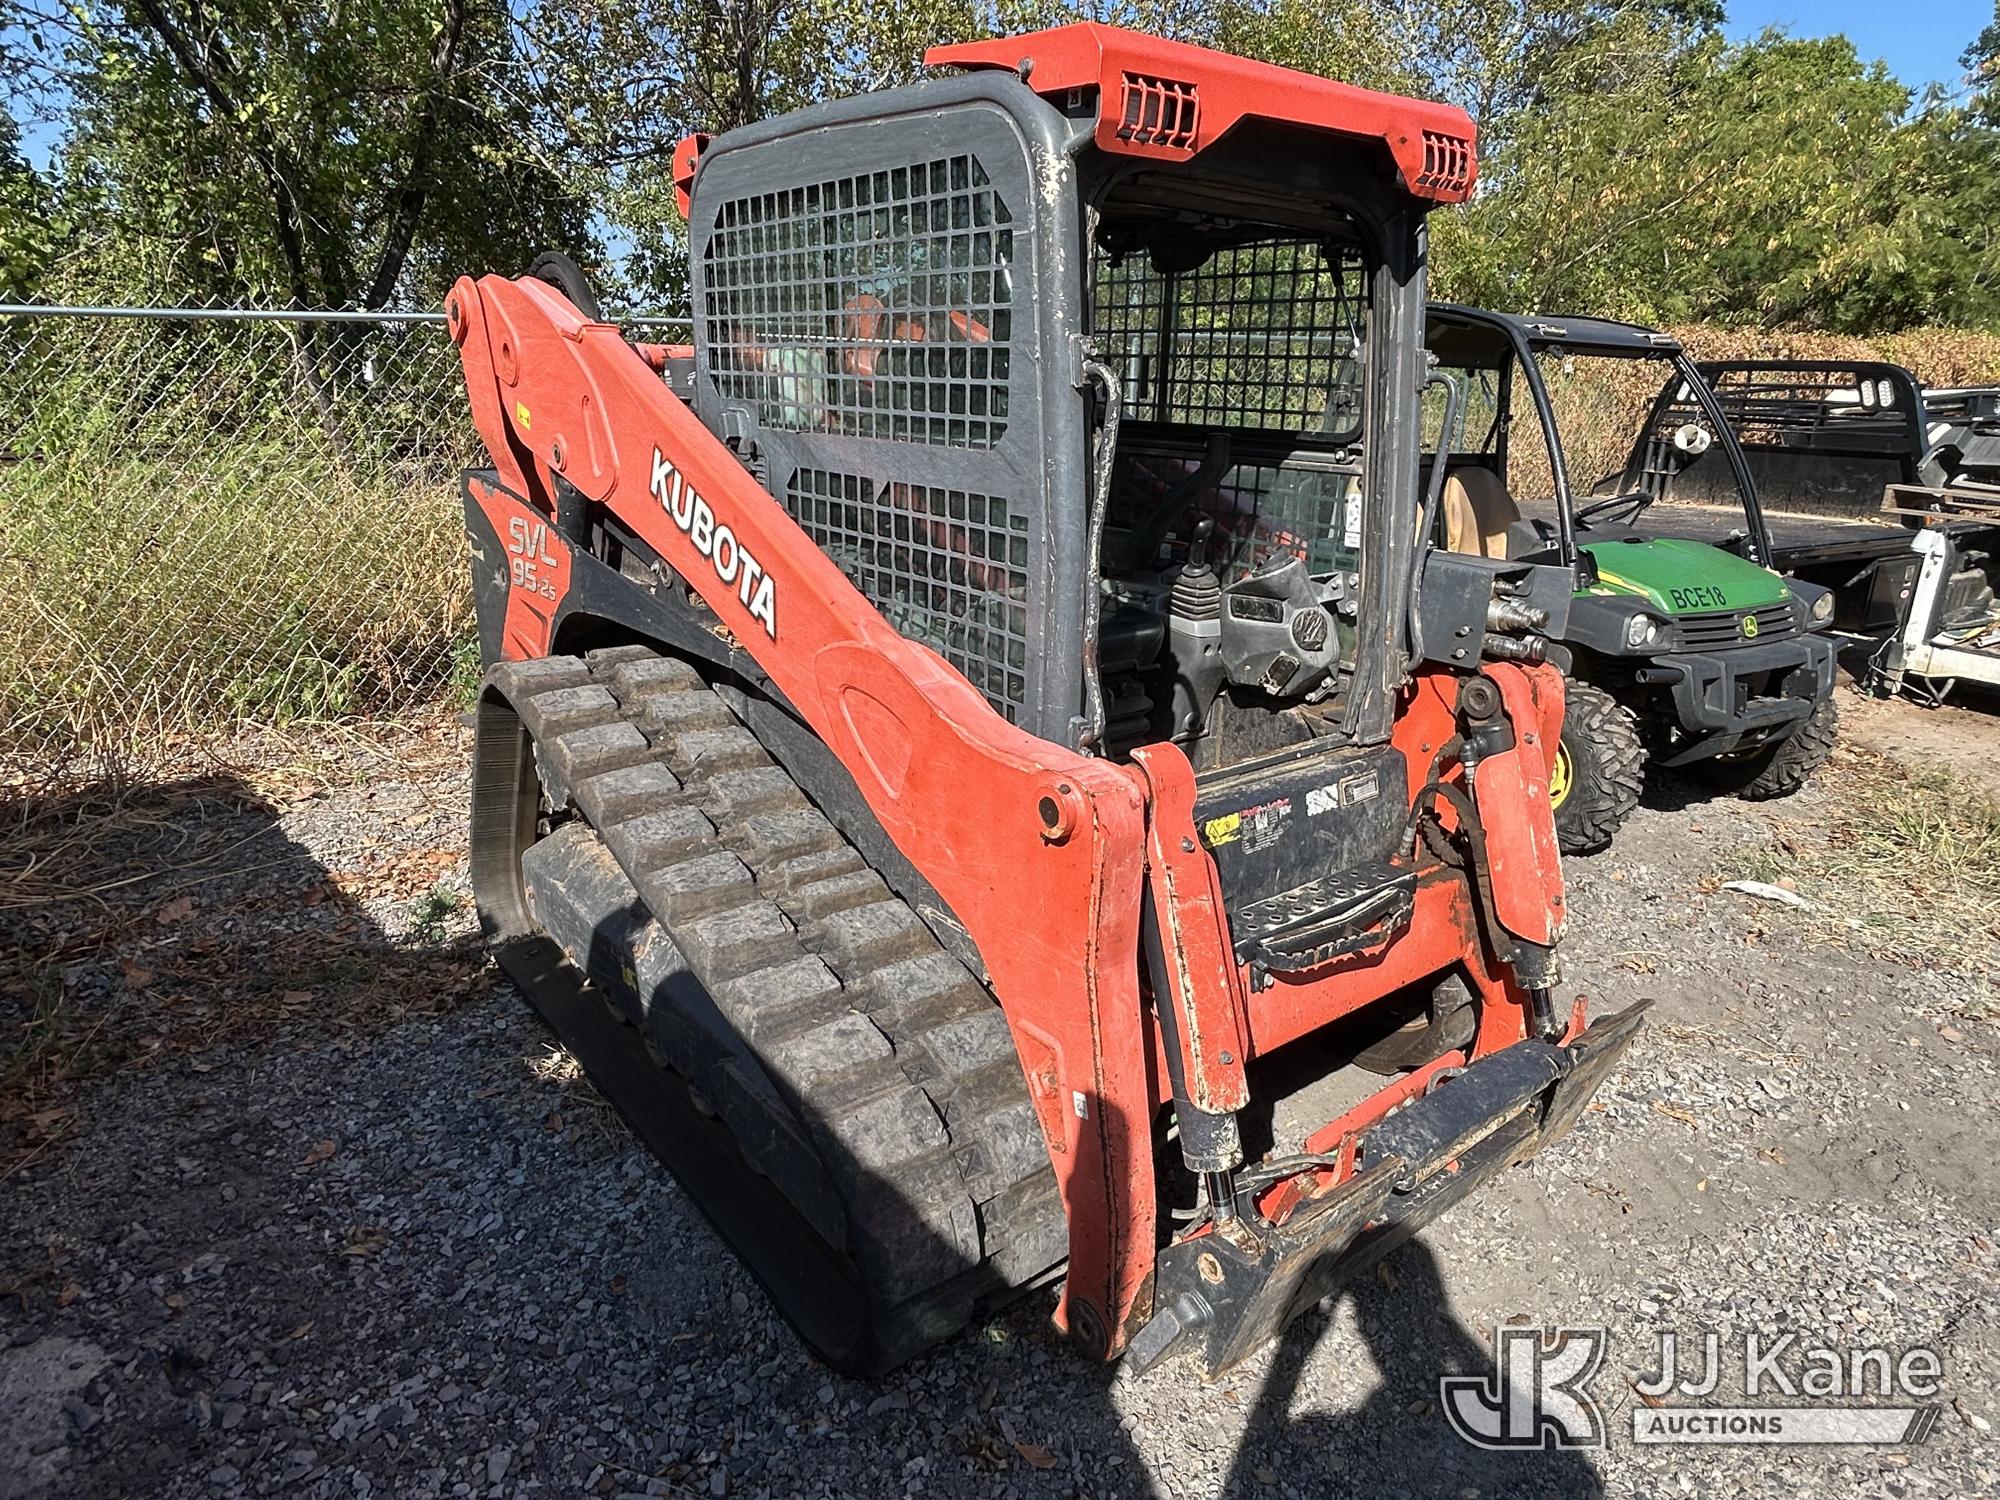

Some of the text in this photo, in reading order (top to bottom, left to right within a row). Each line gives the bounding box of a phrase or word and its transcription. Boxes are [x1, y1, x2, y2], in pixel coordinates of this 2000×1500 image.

[509, 516, 558, 568] SVL
[650, 446, 777, 641] KUBOTA
[1669, 586, 1727, 609] BCE18
